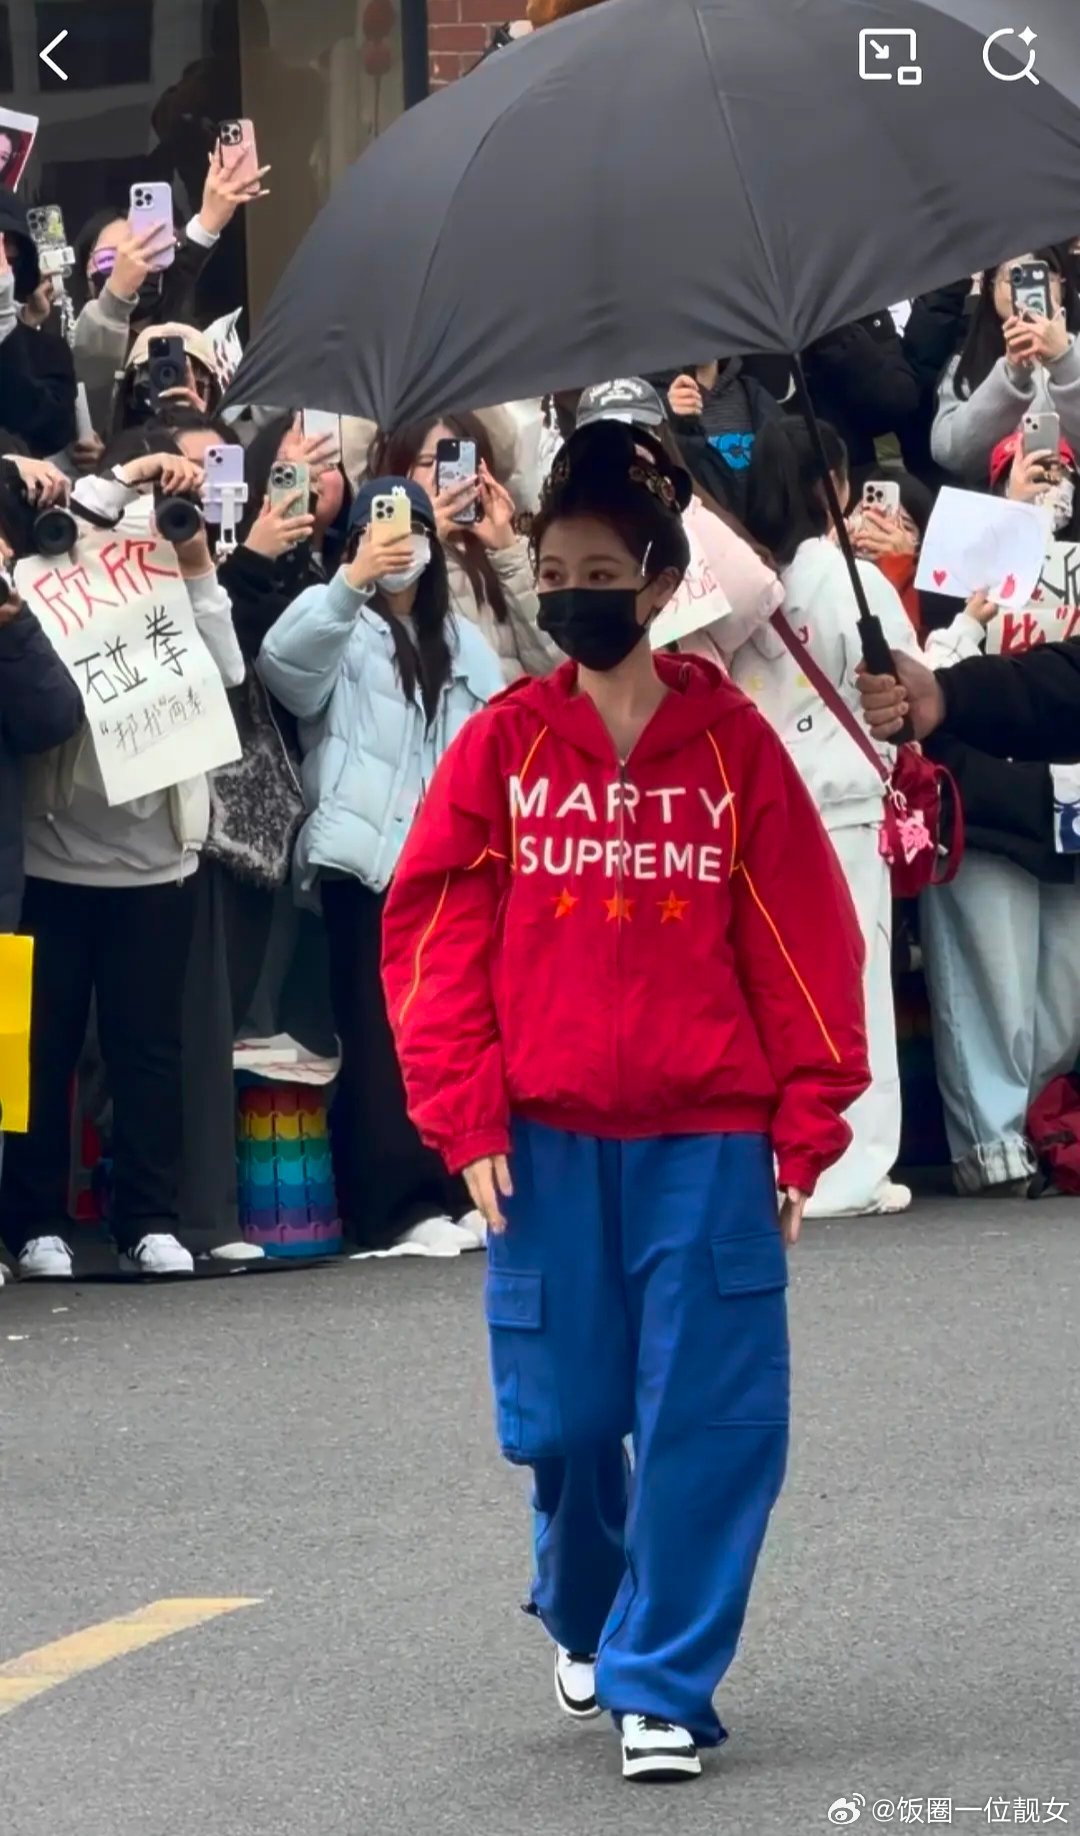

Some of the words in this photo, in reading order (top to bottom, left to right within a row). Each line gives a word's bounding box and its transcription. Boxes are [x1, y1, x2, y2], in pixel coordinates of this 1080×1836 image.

[33, 540, 179, 637] 欣欣
[74, 604, 188, 704] 碰拳
[509, 775, 735, 829] MARTY
[520, 836, 723, 883] SUPREME
